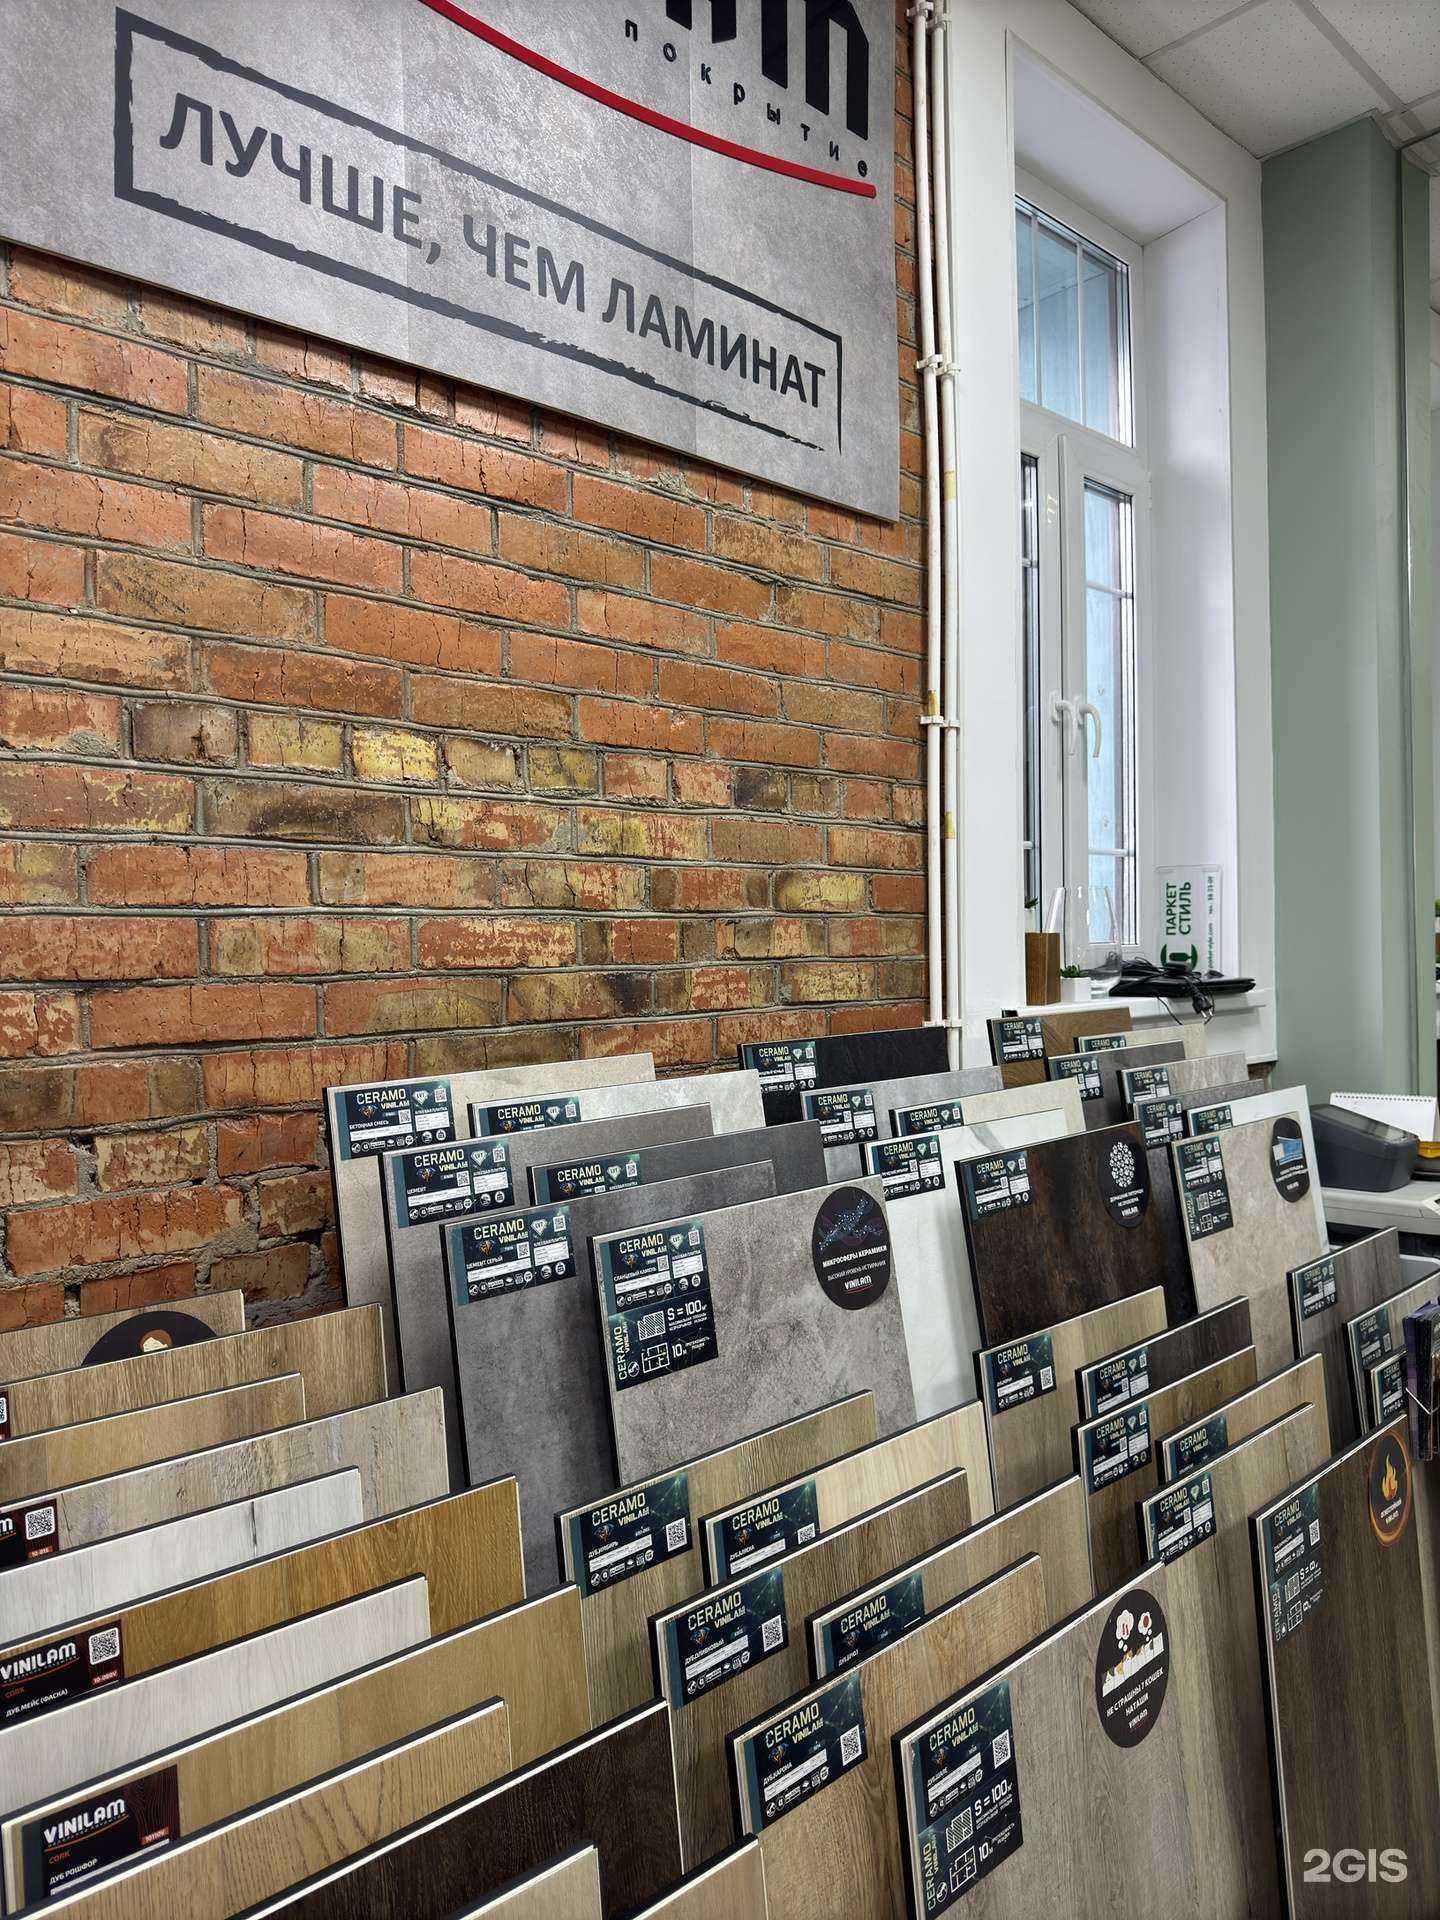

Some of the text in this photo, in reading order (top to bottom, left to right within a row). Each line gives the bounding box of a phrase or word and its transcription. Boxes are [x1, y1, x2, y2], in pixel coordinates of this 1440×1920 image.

[160, 92, 827, 408] ЛУЧШЕ, ЧЕМ ЛАМИНАТ
[1166, 882, 1177, 936] ПАРКЕТ
[1179, 881, 1192, 936] СТИЛЬ
[759, 1046, 789, 1058] CERAMO
[356, 1088, 406, 1105] CERAMO
[381, 1100, 410, 1110] VINILAM
[818, 1093, 849, 1106] CERAMO
[497, 1103, 541, 1120] CERAMO
[519, 1115, 545, 1125] VINILAM
[910, 1108, 938, 1123] CERAMO
[373, 1119, 389, 1127] СМЕСЬ
[414, 1148, 465, 1168] CERAMO
[883, 1141, 914, 1156] CERAMO
[439, 1161, 469, 1172] VINILAM
[557, 1163, 602, 1183] CERAMO
[976, 1159, 1004, 1175] CERAMO
[579, 1176, 605, 1187] VINILAM
[473, 1219, 525, 1240] CERAMO
[499, 1231, 529, 1244] VINILAM
[619, 1233, 664, 1254] CERAMO
[641, 1245, 667, 1257] VINILAM
[822, 1245, 888, 1268] МИКРОСФЕРЫ КЕРАМИКИ
[844, 1275, 872, 1290] VINILAM
[613, 1326, 628, 1380] CERAMO
[997, 1343, 1029, 1365] CERAMO
[1099, 1359, 1126, 1380] CERAMO
[1096, 1417, 1125, 1439] CERAMO
[1180, 1428, 1207, 1452] CERAMO
[591, 1492, 646, 1527] CERAMO
[1160, 1487, 1188, 1512] CERAMO
[618, 1506, 650, 1527] VINILAM
[732, 1498, 780, 1531] CERAMO
[755, 1511, 784, 1531] VINILAM
[1274, 1500, 1300, 1527] CERAMO
[688, 1591, 742, 1631] CERAMO
[714, 1605, 746, 1628] VINILAM
[840, 1595, 887, 1634] CERAMO
[863, 1608, 892, 1631] VINILAM
[0, 1642, 77, 1680] VINILAM
[5, 1688, 68, 1718] ДУБ МЕЙС (ФАСКА)
[1106, 1706, 1114, 1718] НЕ
[1113, 1684, 1141, 1712] СТРАШНЫ
[765, 1702, 820, 1748] CERAMO
[791, 1717, 824, 1744] VINILAM
[928, 1707, 975, 1752] CERAMO
[951, 1721, 979, 1748] VINILAM
[43, 1798, 125, 1845] VINILAM
[49, 1850, 71, 1865] CORK
[50, 1858, 98, 1885] ДУБ РОШФОР
[923, 1842, 936, 1911] CERAMO
